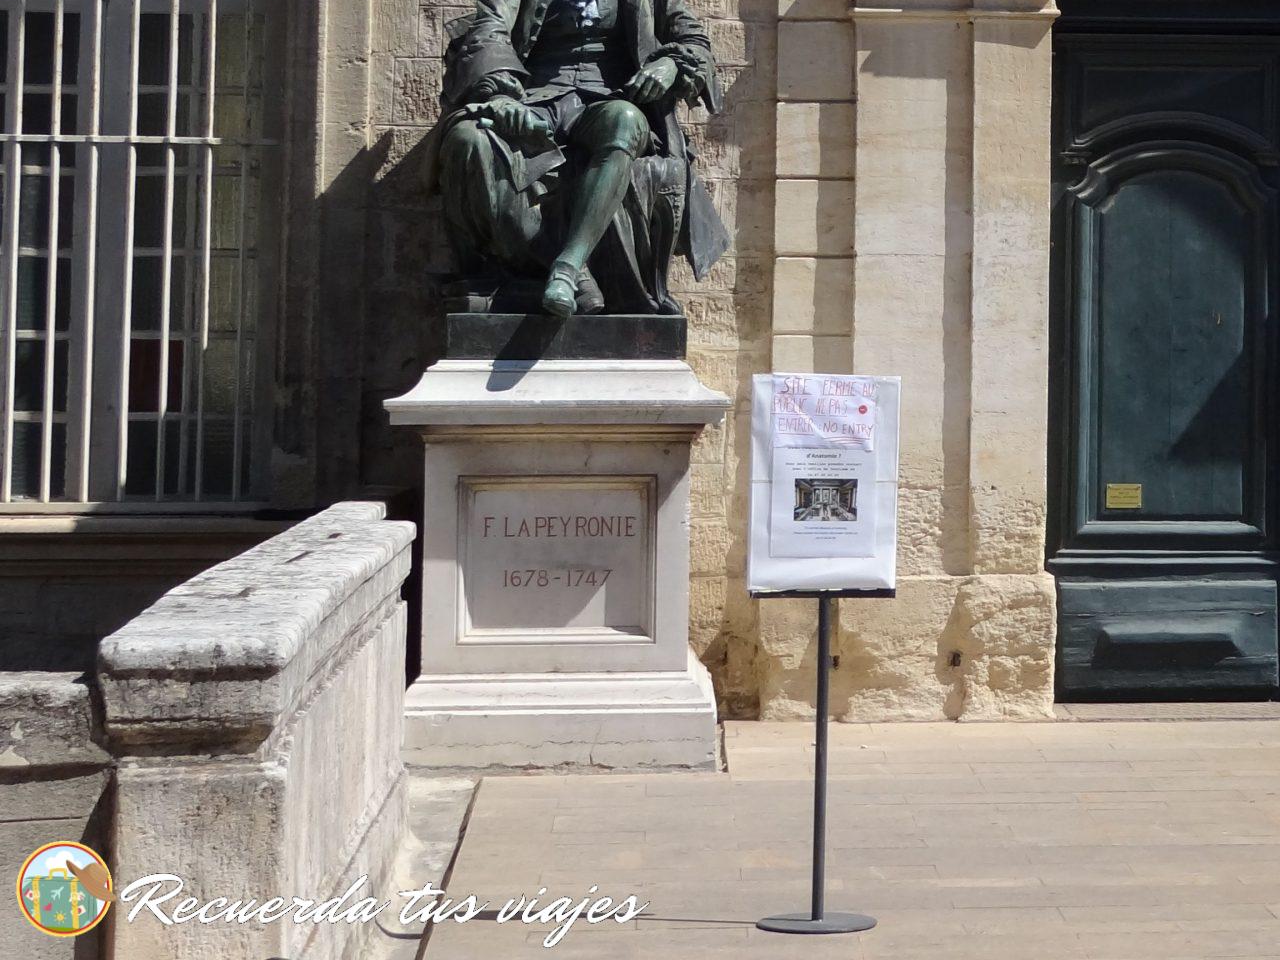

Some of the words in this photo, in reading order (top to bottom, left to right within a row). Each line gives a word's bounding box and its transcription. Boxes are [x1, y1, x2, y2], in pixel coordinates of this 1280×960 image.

[823, 421, 838, 433] NO
[842, 424, 874, 438] ENTRY
[503, 516, 637, 538] LAPEYRONIE
[503, 569, 613, 588] 1678-1747
